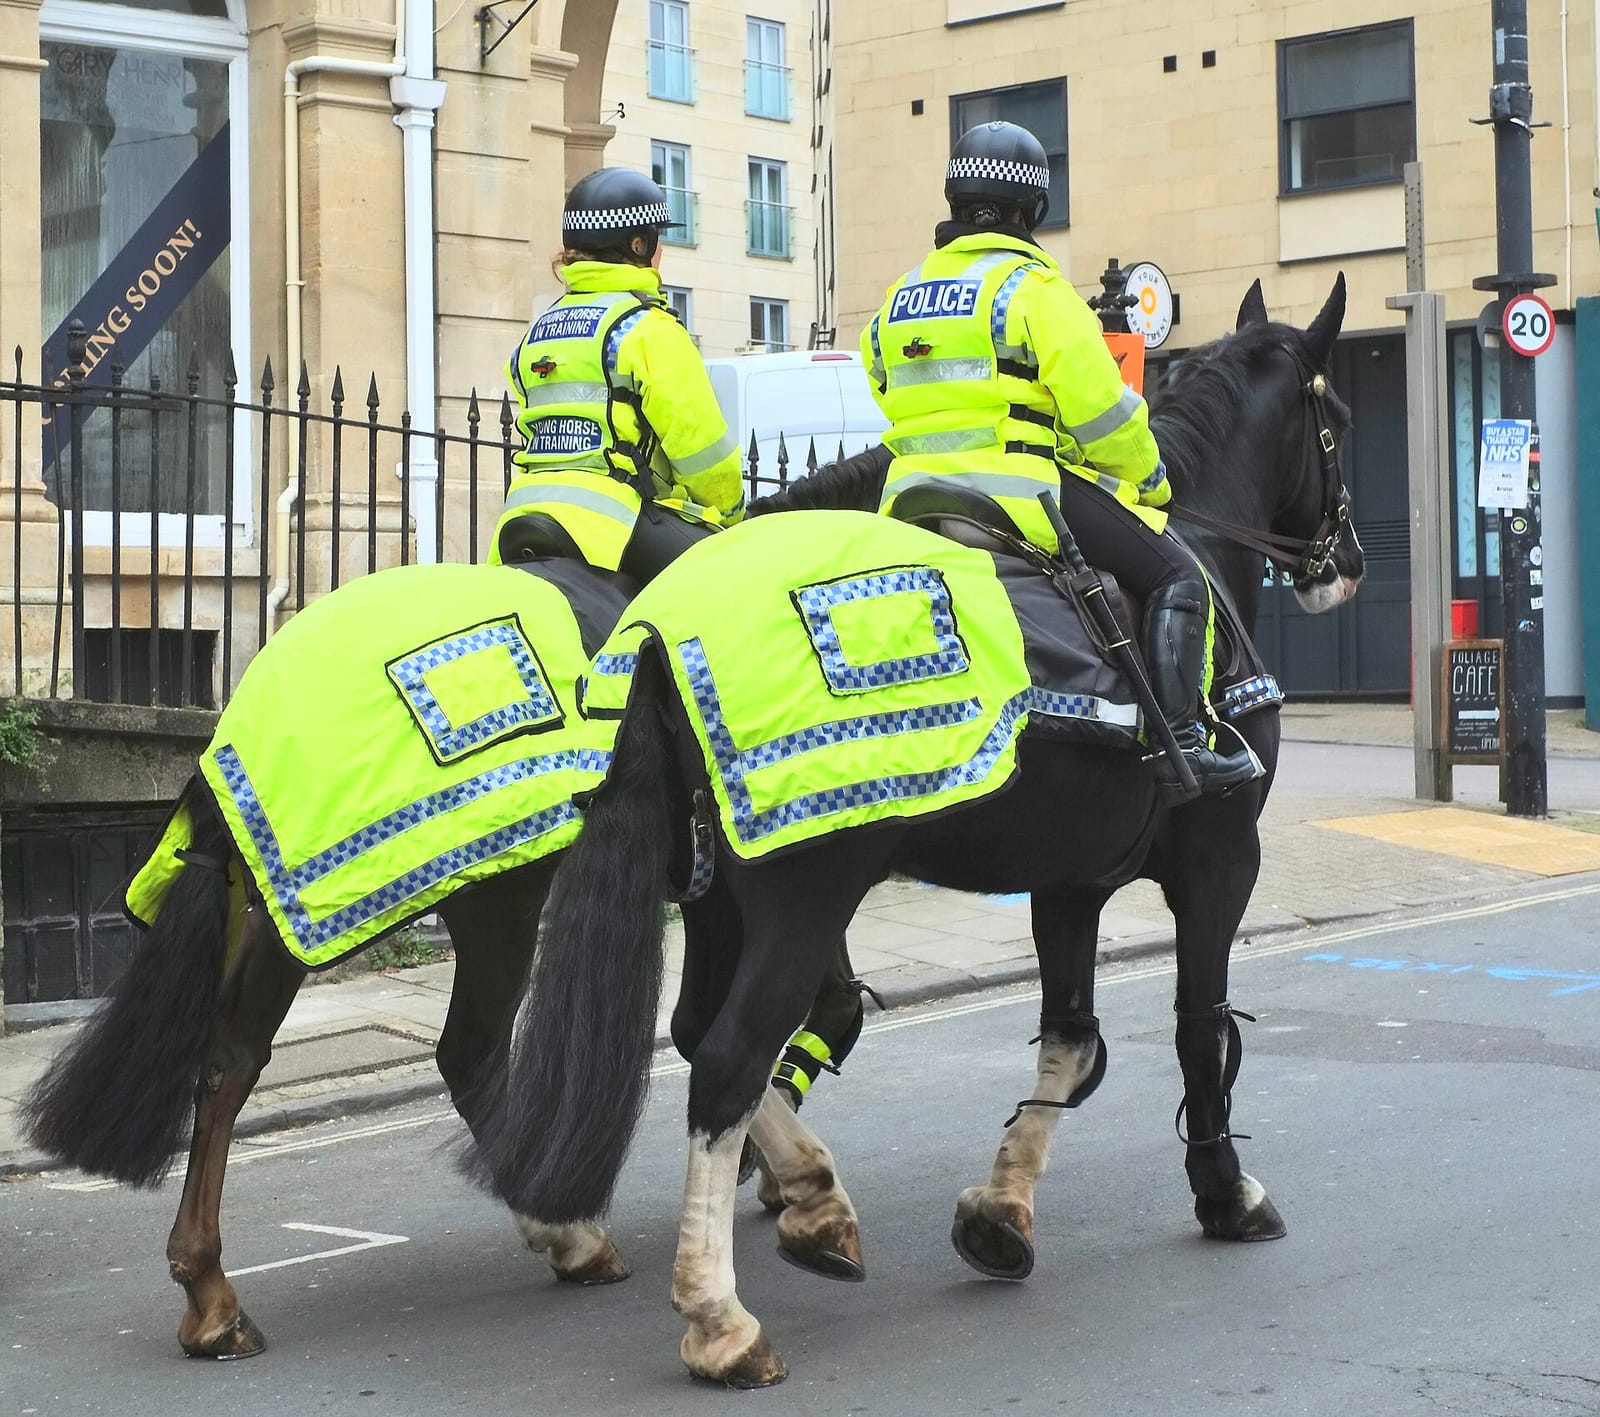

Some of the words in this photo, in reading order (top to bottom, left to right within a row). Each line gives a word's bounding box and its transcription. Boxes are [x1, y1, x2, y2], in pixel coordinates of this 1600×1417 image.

[126, 218, 202, 312] SOON!
[1138, 271, 1158, 284] YOUR
[892, 283, 976, 318] POLICE
[567, 308, 603, 321] HORSE
[534, 325, 546, 340] IN
[545, 321, 591, 337] TRAINING
[1128, 312, 1168, 340] APATMENT
[1512, 312, 1546, 337] 20
[559, 419, 598, 436] HORSE
[1486, 427, 1500, 436] BUY
[1507, 427, 1525, 436] STAR
[540, 435, 591, 450] TRAINING
[1486, 436, 1509, 445] THANK
[1511, 436, 1524, 445] THE
[1487, 445, 1521, 462] NHS
